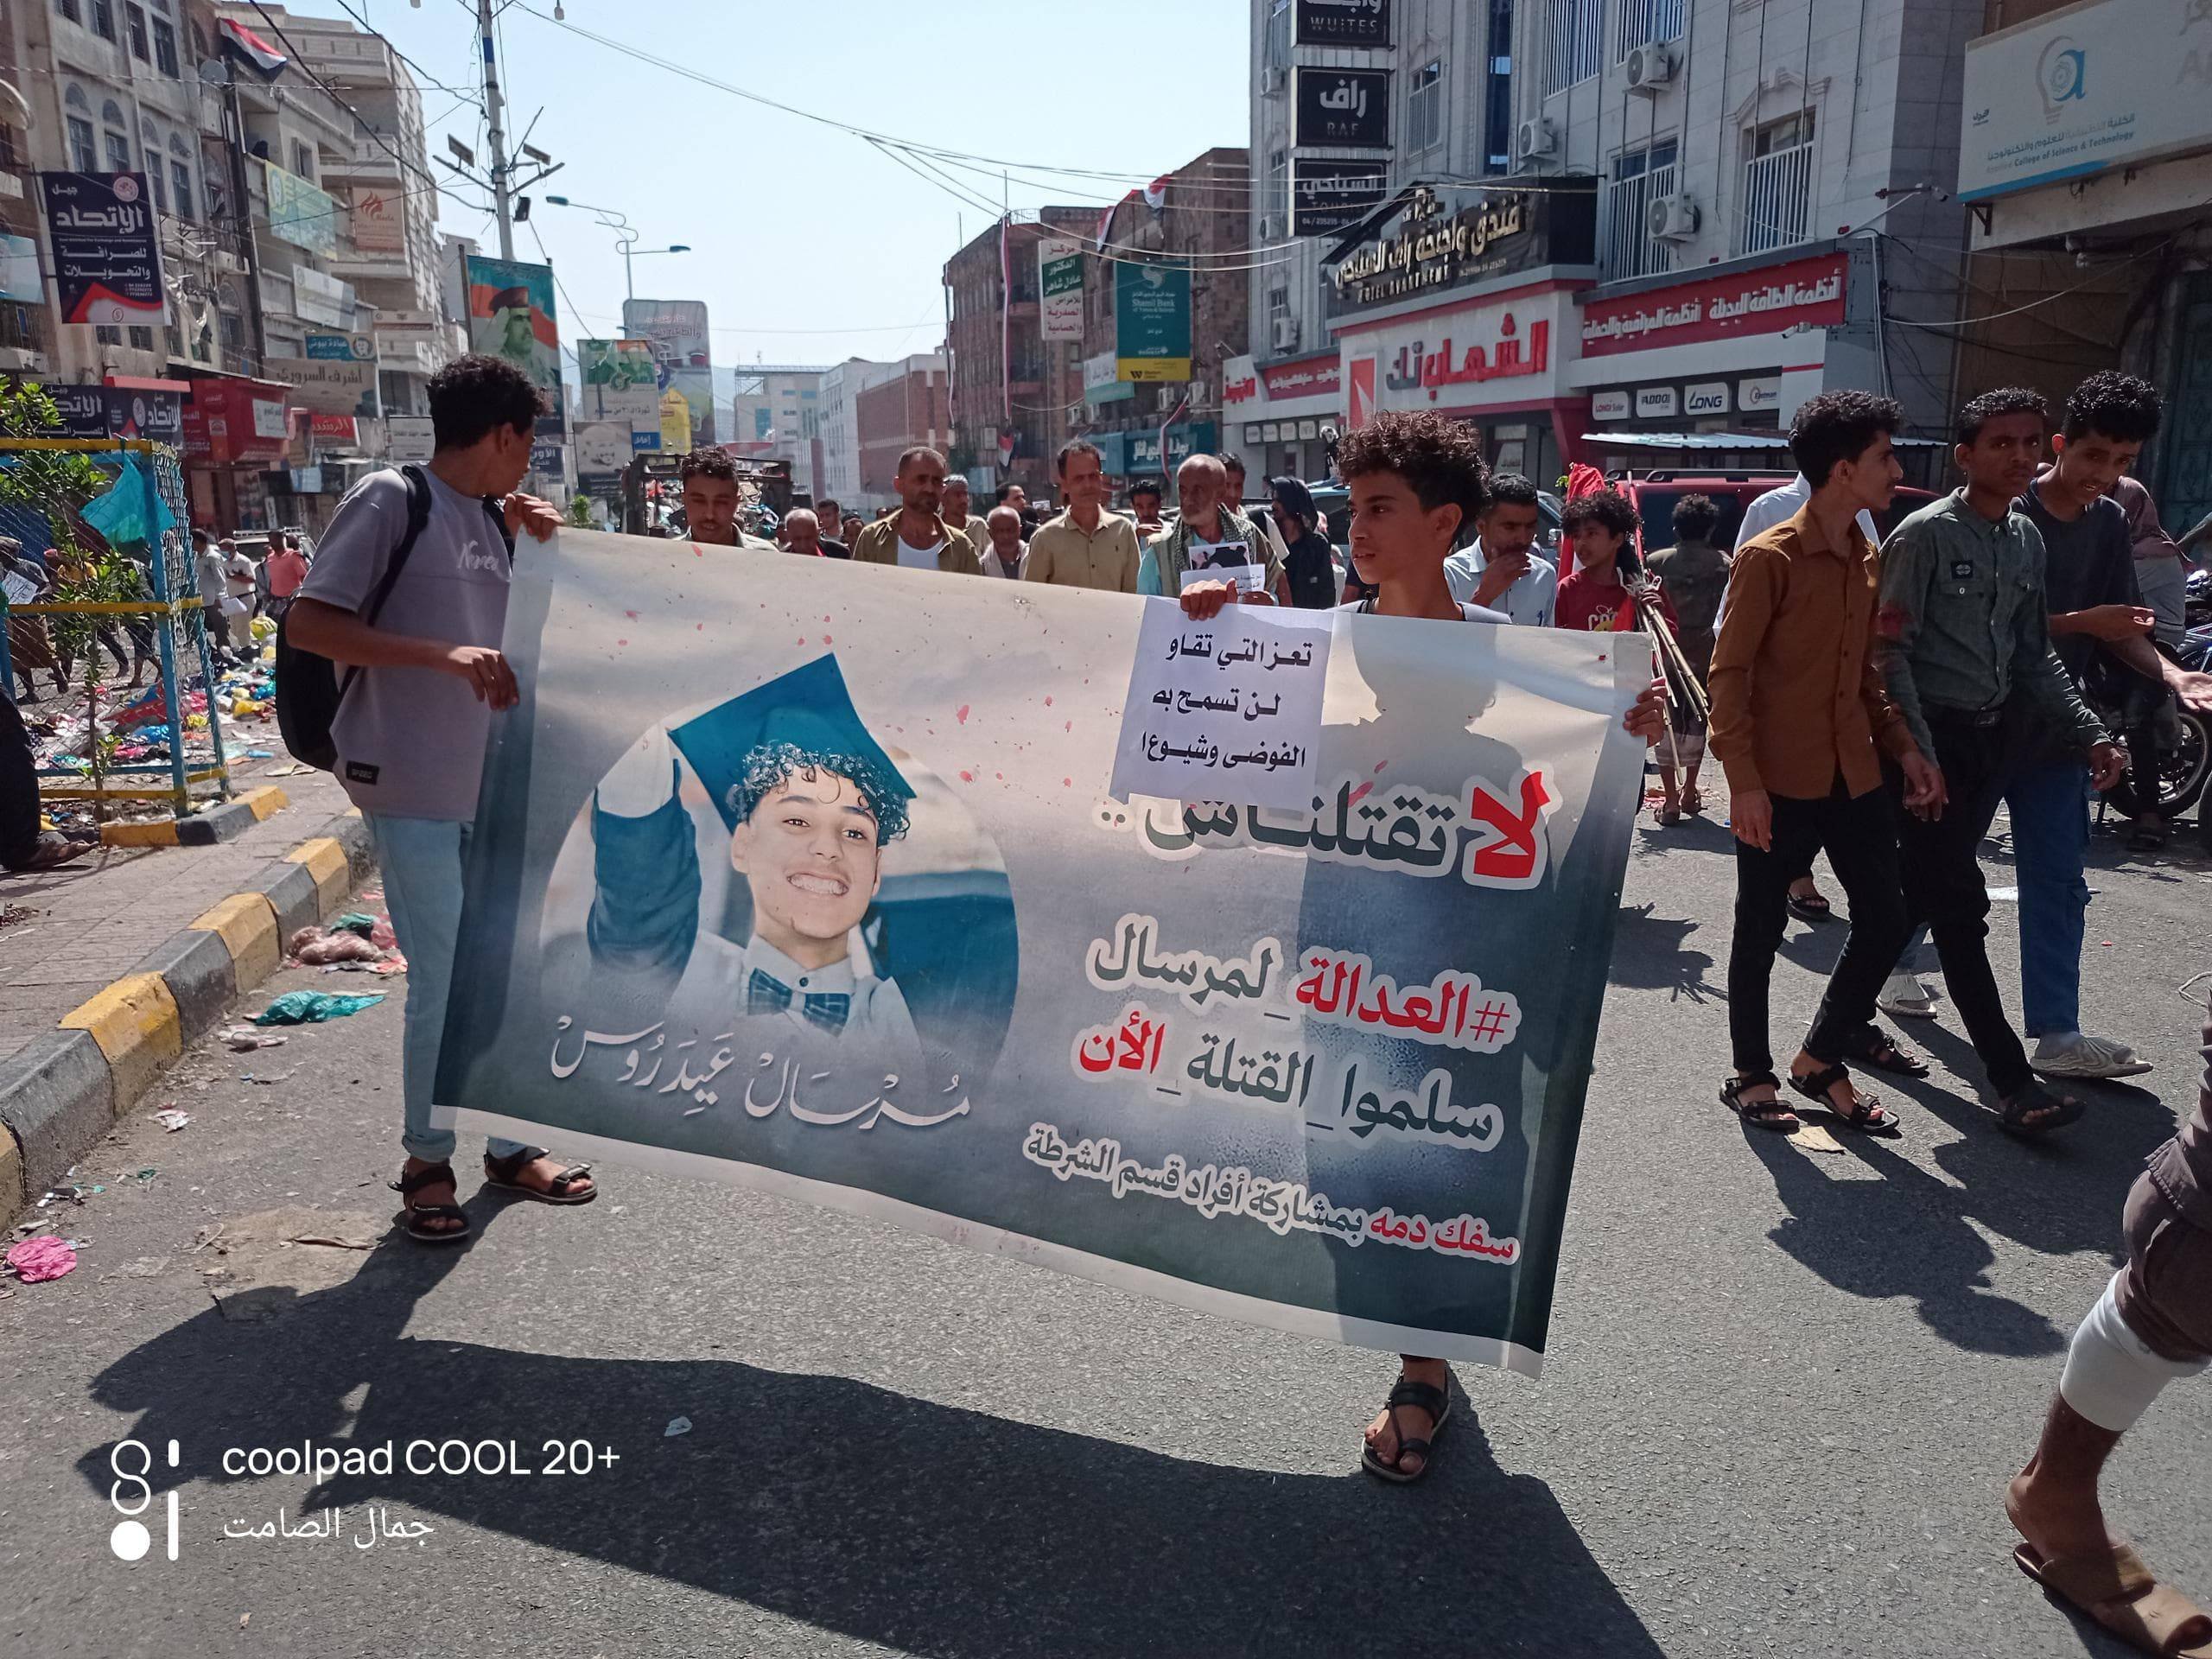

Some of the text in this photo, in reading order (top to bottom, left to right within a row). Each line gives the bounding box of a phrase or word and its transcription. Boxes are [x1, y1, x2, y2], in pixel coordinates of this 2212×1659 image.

[1319, 79, 1367, 118] راف
[2014, 155, 2040, 168] College
[52, 183, 78, 196] جيل
[1688, 390, 1723, 410] LONG
[1166, 633, 1313, 671] تعز التي تقاو
[1153, 688, 1281, 721] لن تسمح به
[1222, 741, 1306, 772] الفوضى
[1471, 771, 1550, 880] لا
[1027, 1127, 1515, 1260] سفك دمه بمشاركة أفراد قسم الشرطة
